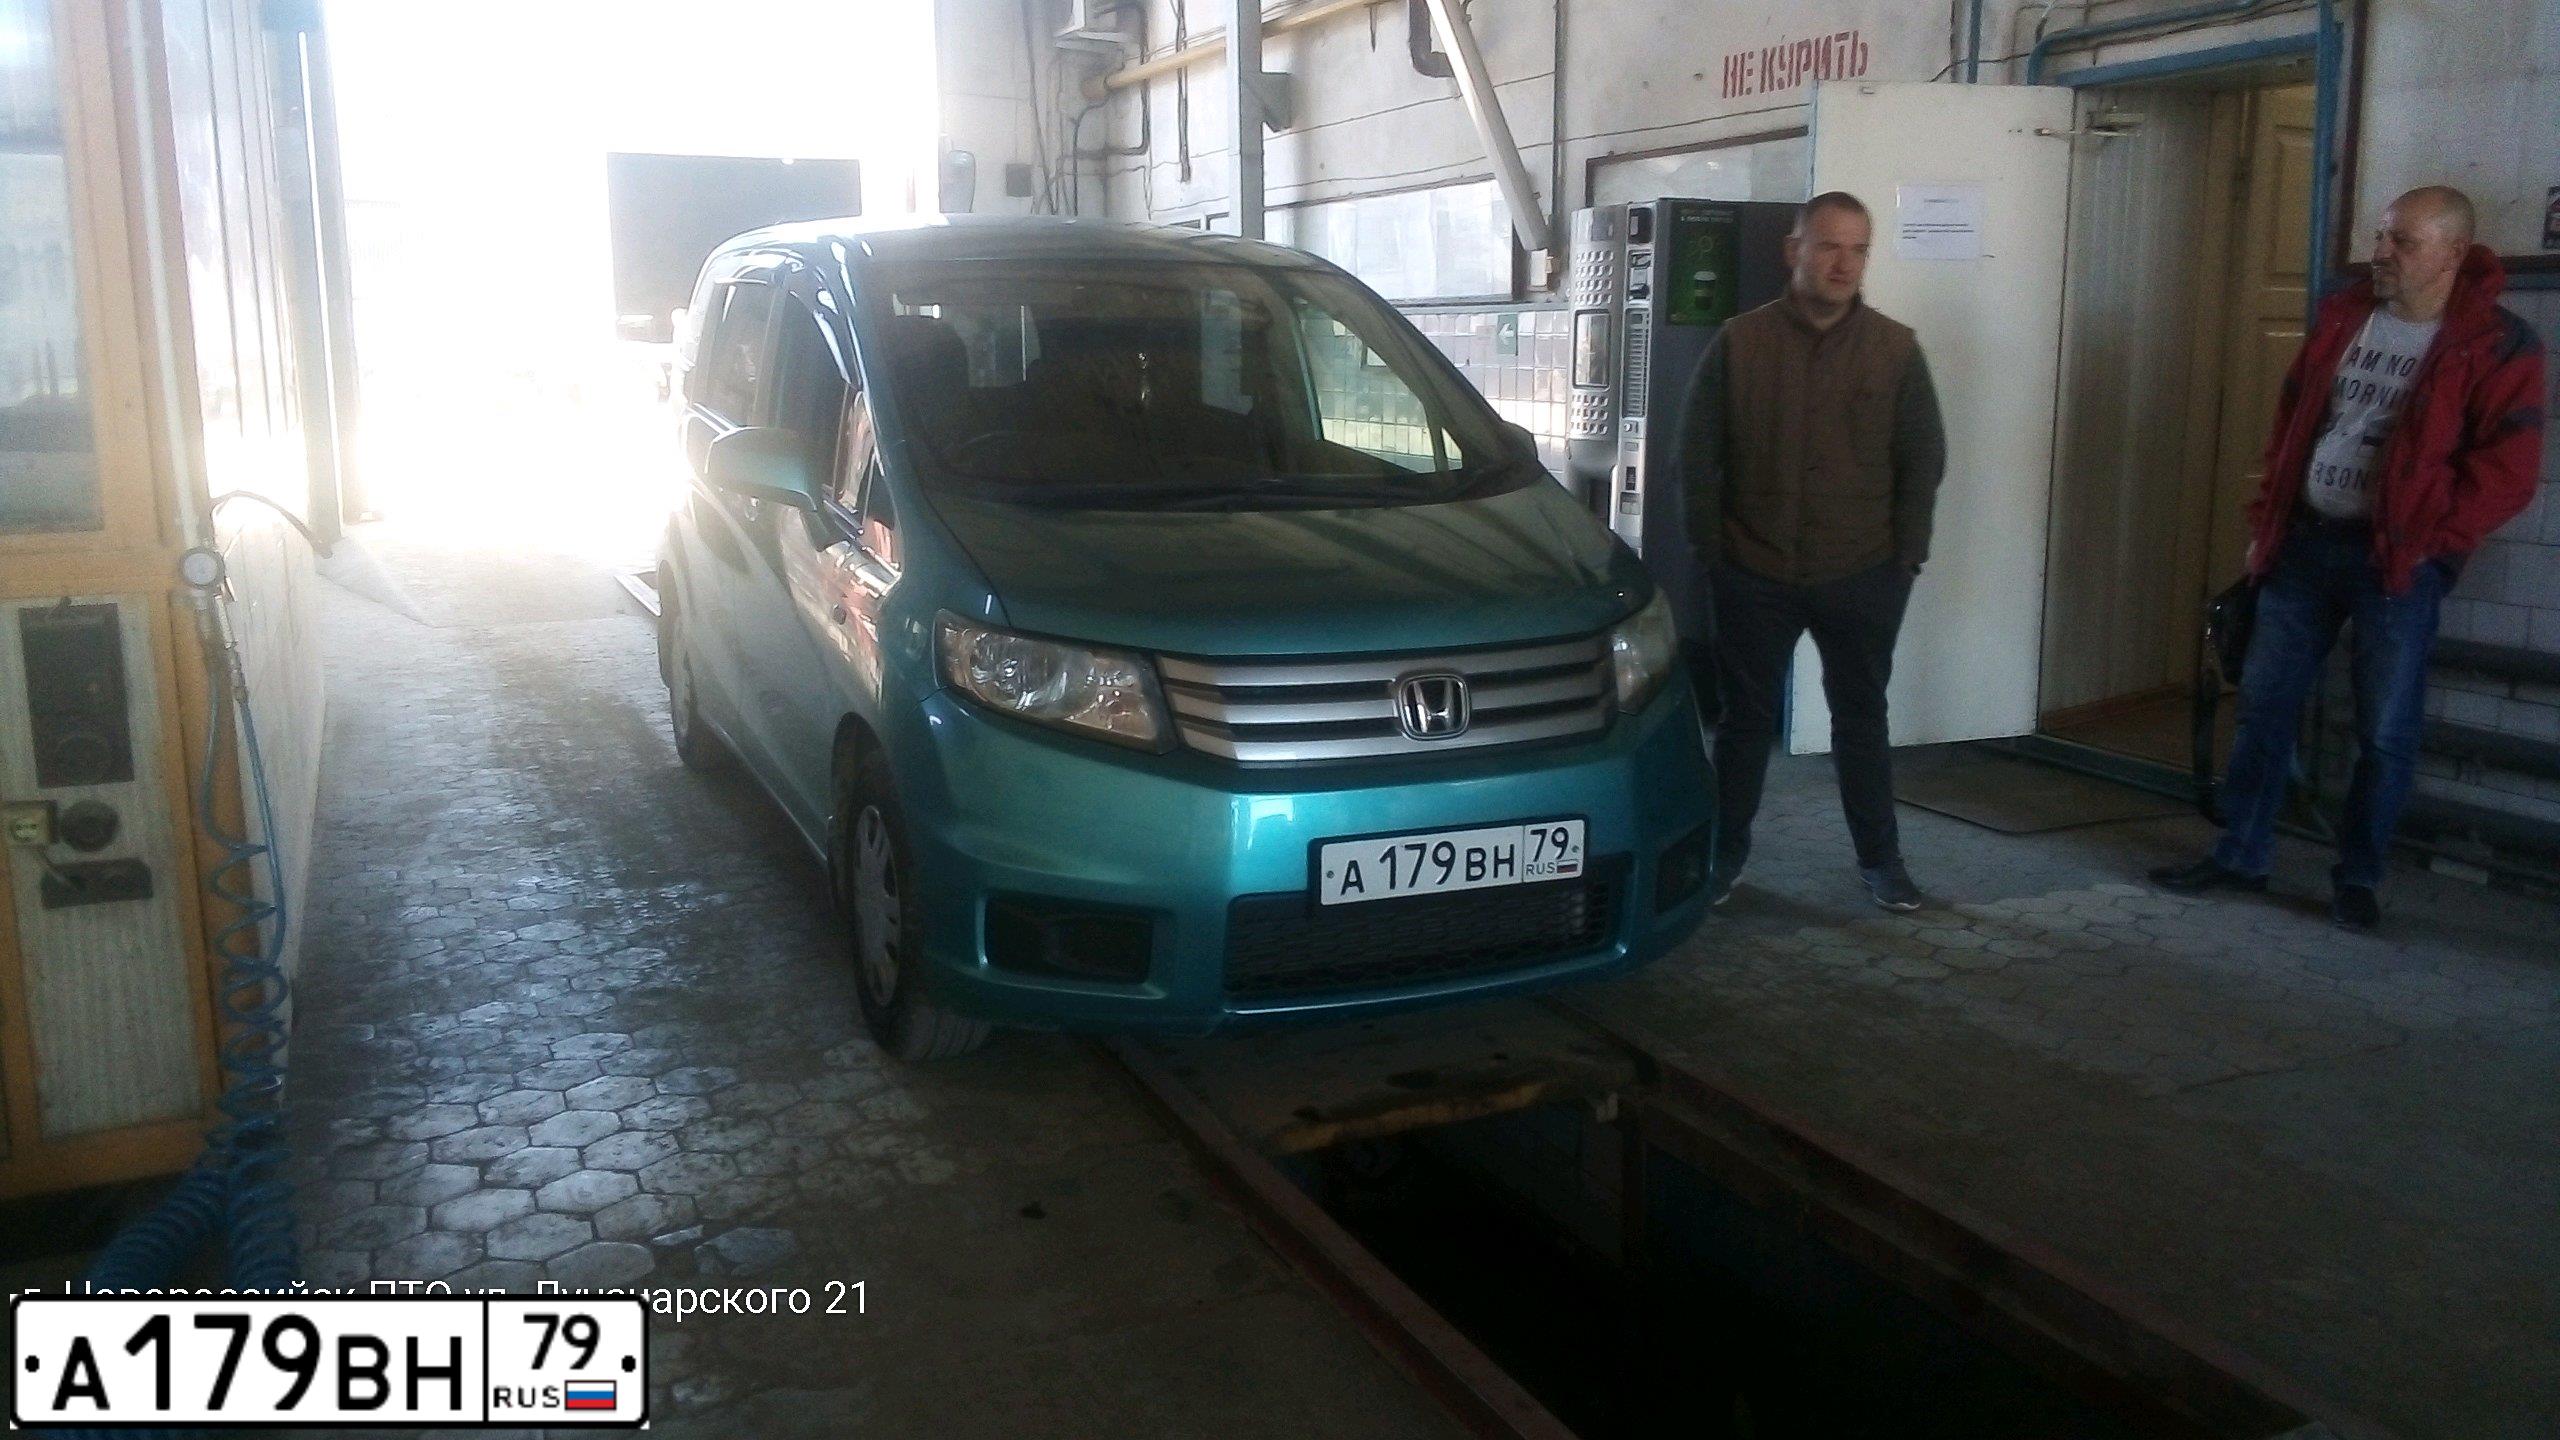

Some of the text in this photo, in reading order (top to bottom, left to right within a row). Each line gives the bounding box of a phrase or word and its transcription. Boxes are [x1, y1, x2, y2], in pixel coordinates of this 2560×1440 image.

[1722, 30, 1869, 99] НЕ КУРИТЬ
[2346, 346, 2416, 378] AM NO
[2336, 375, 2399, 409] MORNI
[2315, 461, 2369, 490] RSON
[1530, 827, 1570, 862] 79
[1525, 862, 1556, 876] RUS
